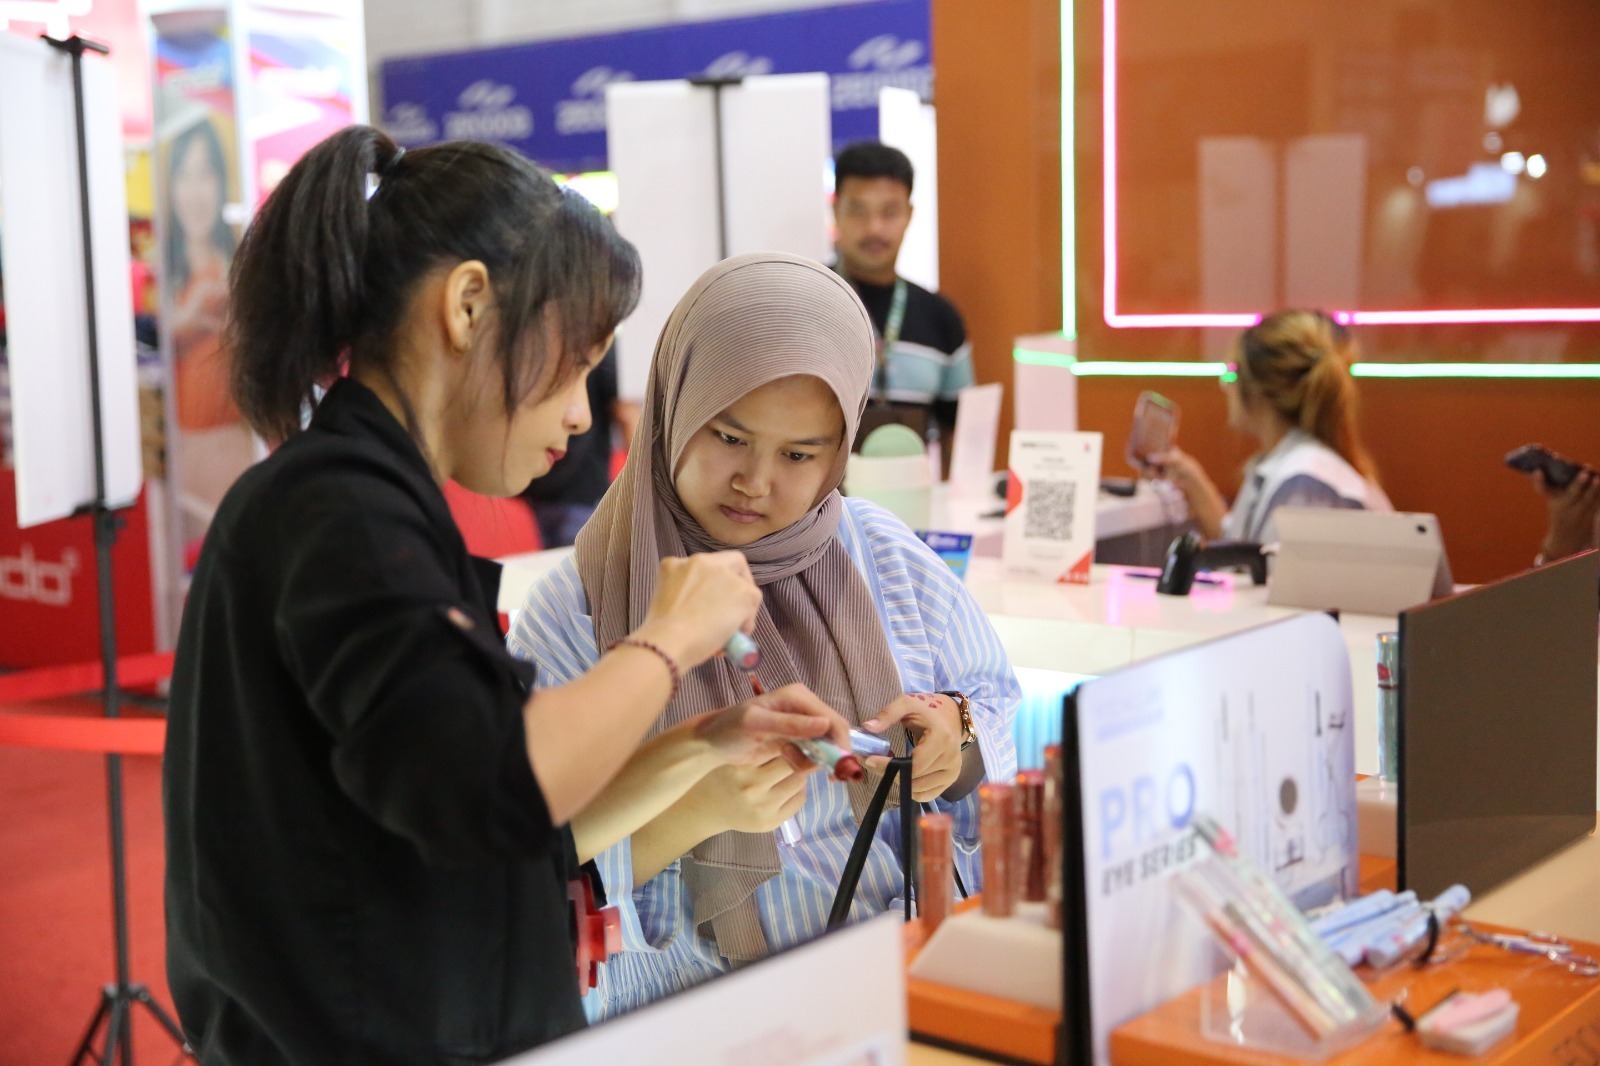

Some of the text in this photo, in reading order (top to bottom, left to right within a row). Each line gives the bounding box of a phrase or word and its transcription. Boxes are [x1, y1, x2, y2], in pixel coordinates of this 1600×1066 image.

[1099, 761, 1196, 862] PRO
[1102, 832, 1196, 897] EYE SERIES
